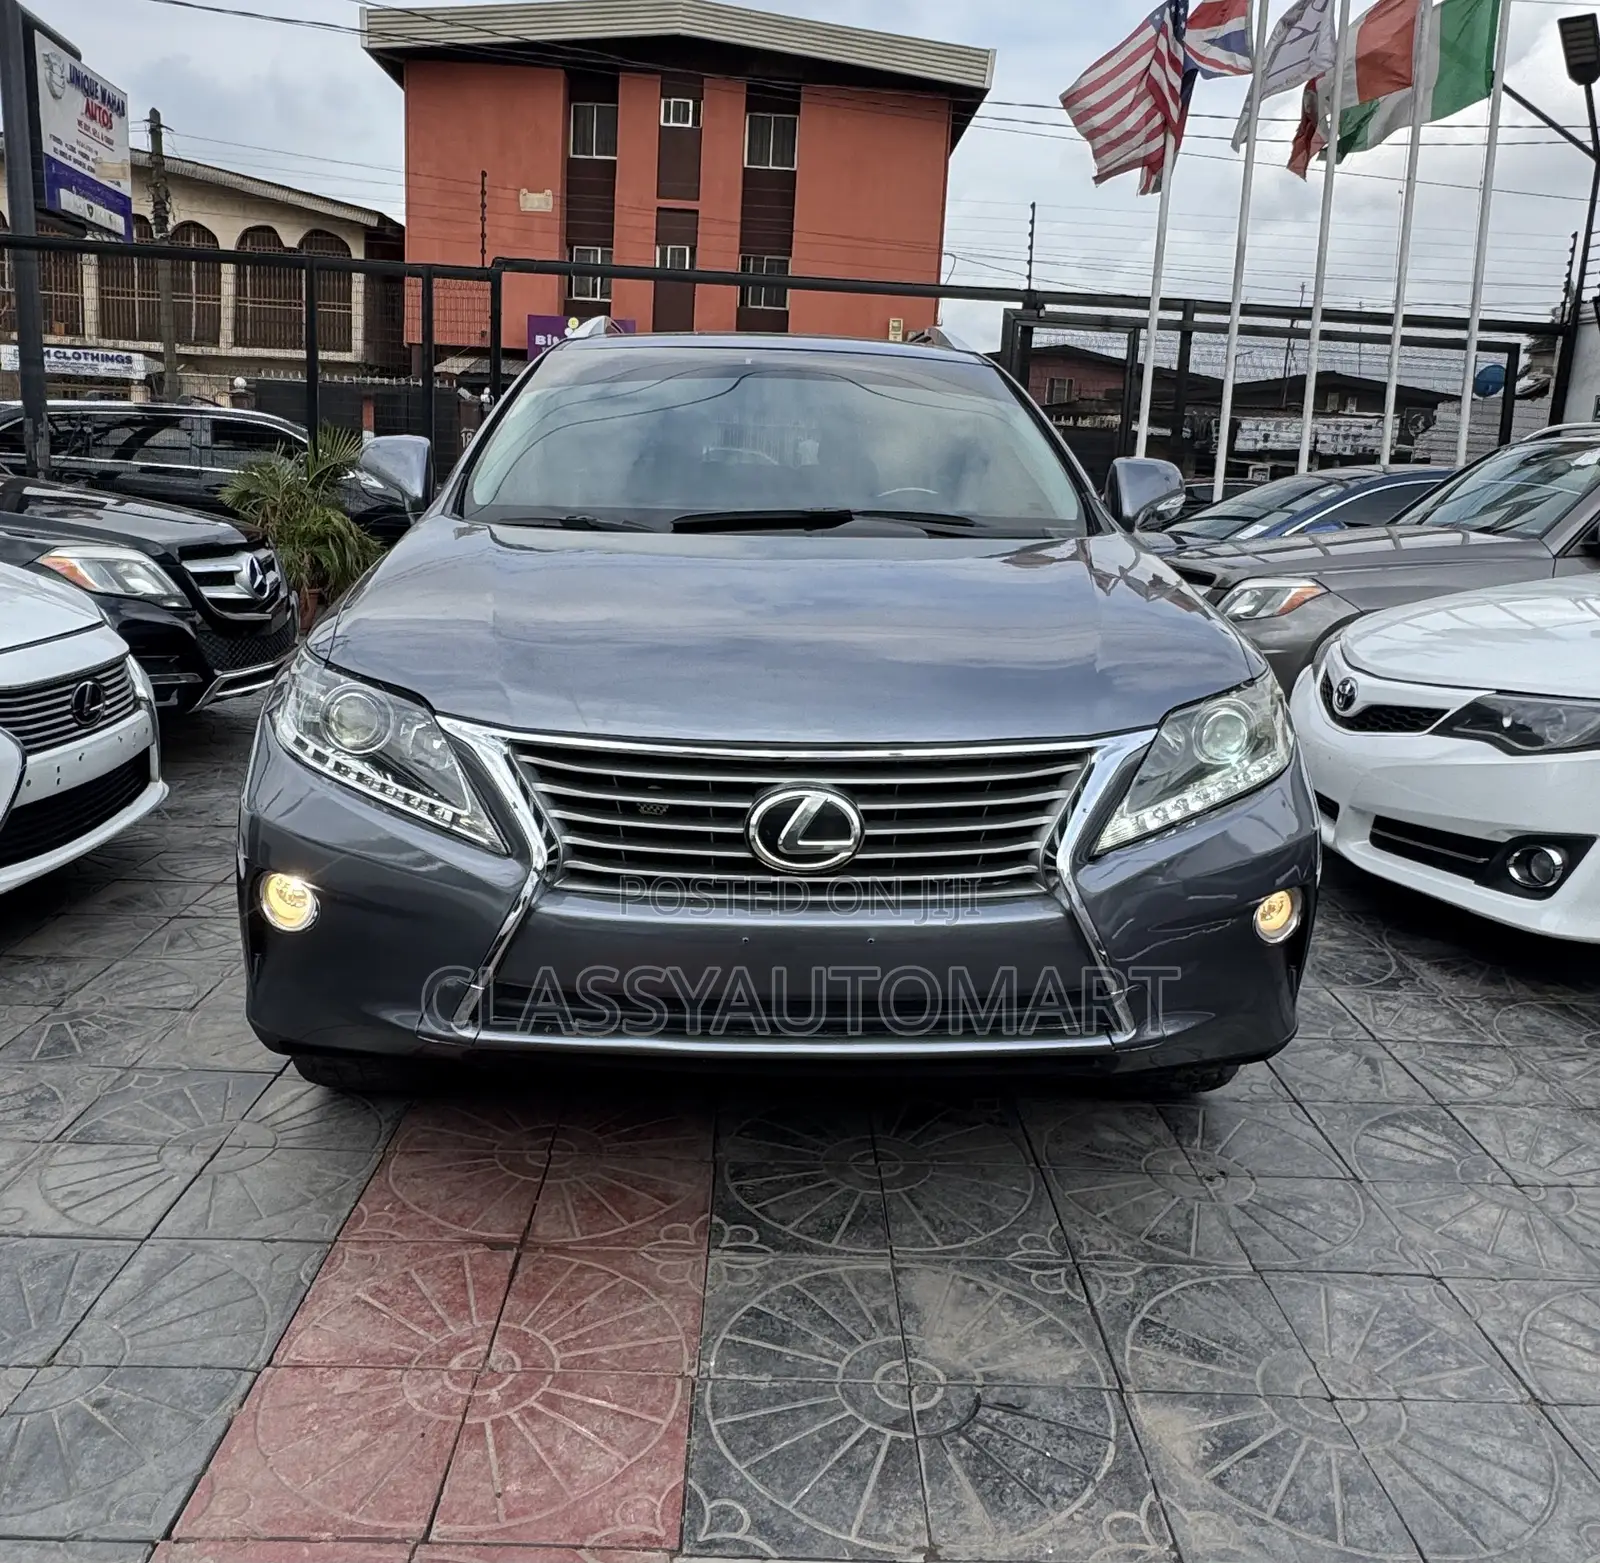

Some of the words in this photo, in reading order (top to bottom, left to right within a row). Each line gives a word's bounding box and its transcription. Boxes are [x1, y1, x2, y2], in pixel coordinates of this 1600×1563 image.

[67, 63, 99, 100] UNIQUE
[85, 97, 113, 130] AUTOS
[54, 350, 133, 364] CLOTHINGS
